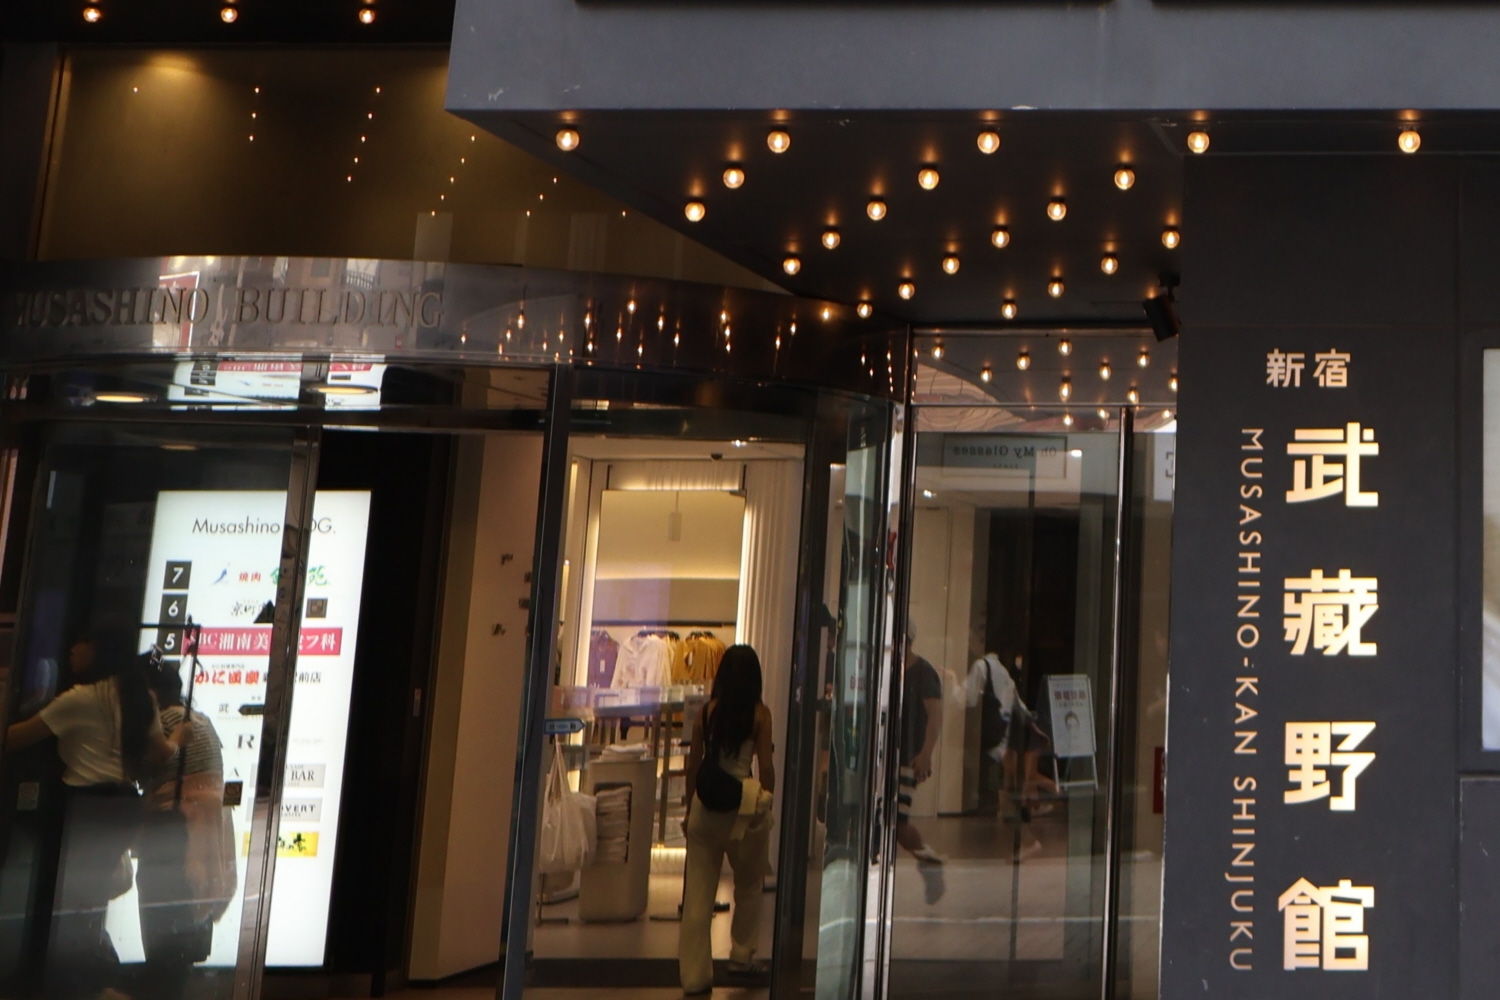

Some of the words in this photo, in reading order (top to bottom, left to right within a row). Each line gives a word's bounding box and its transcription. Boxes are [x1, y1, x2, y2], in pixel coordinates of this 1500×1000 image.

[17, 286, 209, 329] MUSASHINO
[235, 287, 444, 329] BUILDING
[1266, 348, 1352, 389] 新宿
[192, 515, 280, 534] Musashino
[172, 567, 184, 584] 7
[238, 571, 261, 582] 焼肉
[1233, 427, 1264, 755] MUSASHINO-KAN
[168, 600, 179, 616] 6
[164, 633, 176, 650] 5
[291, 770, 315, 781] BAR
[1224, 776, 1258, 972] SHINJUKU
